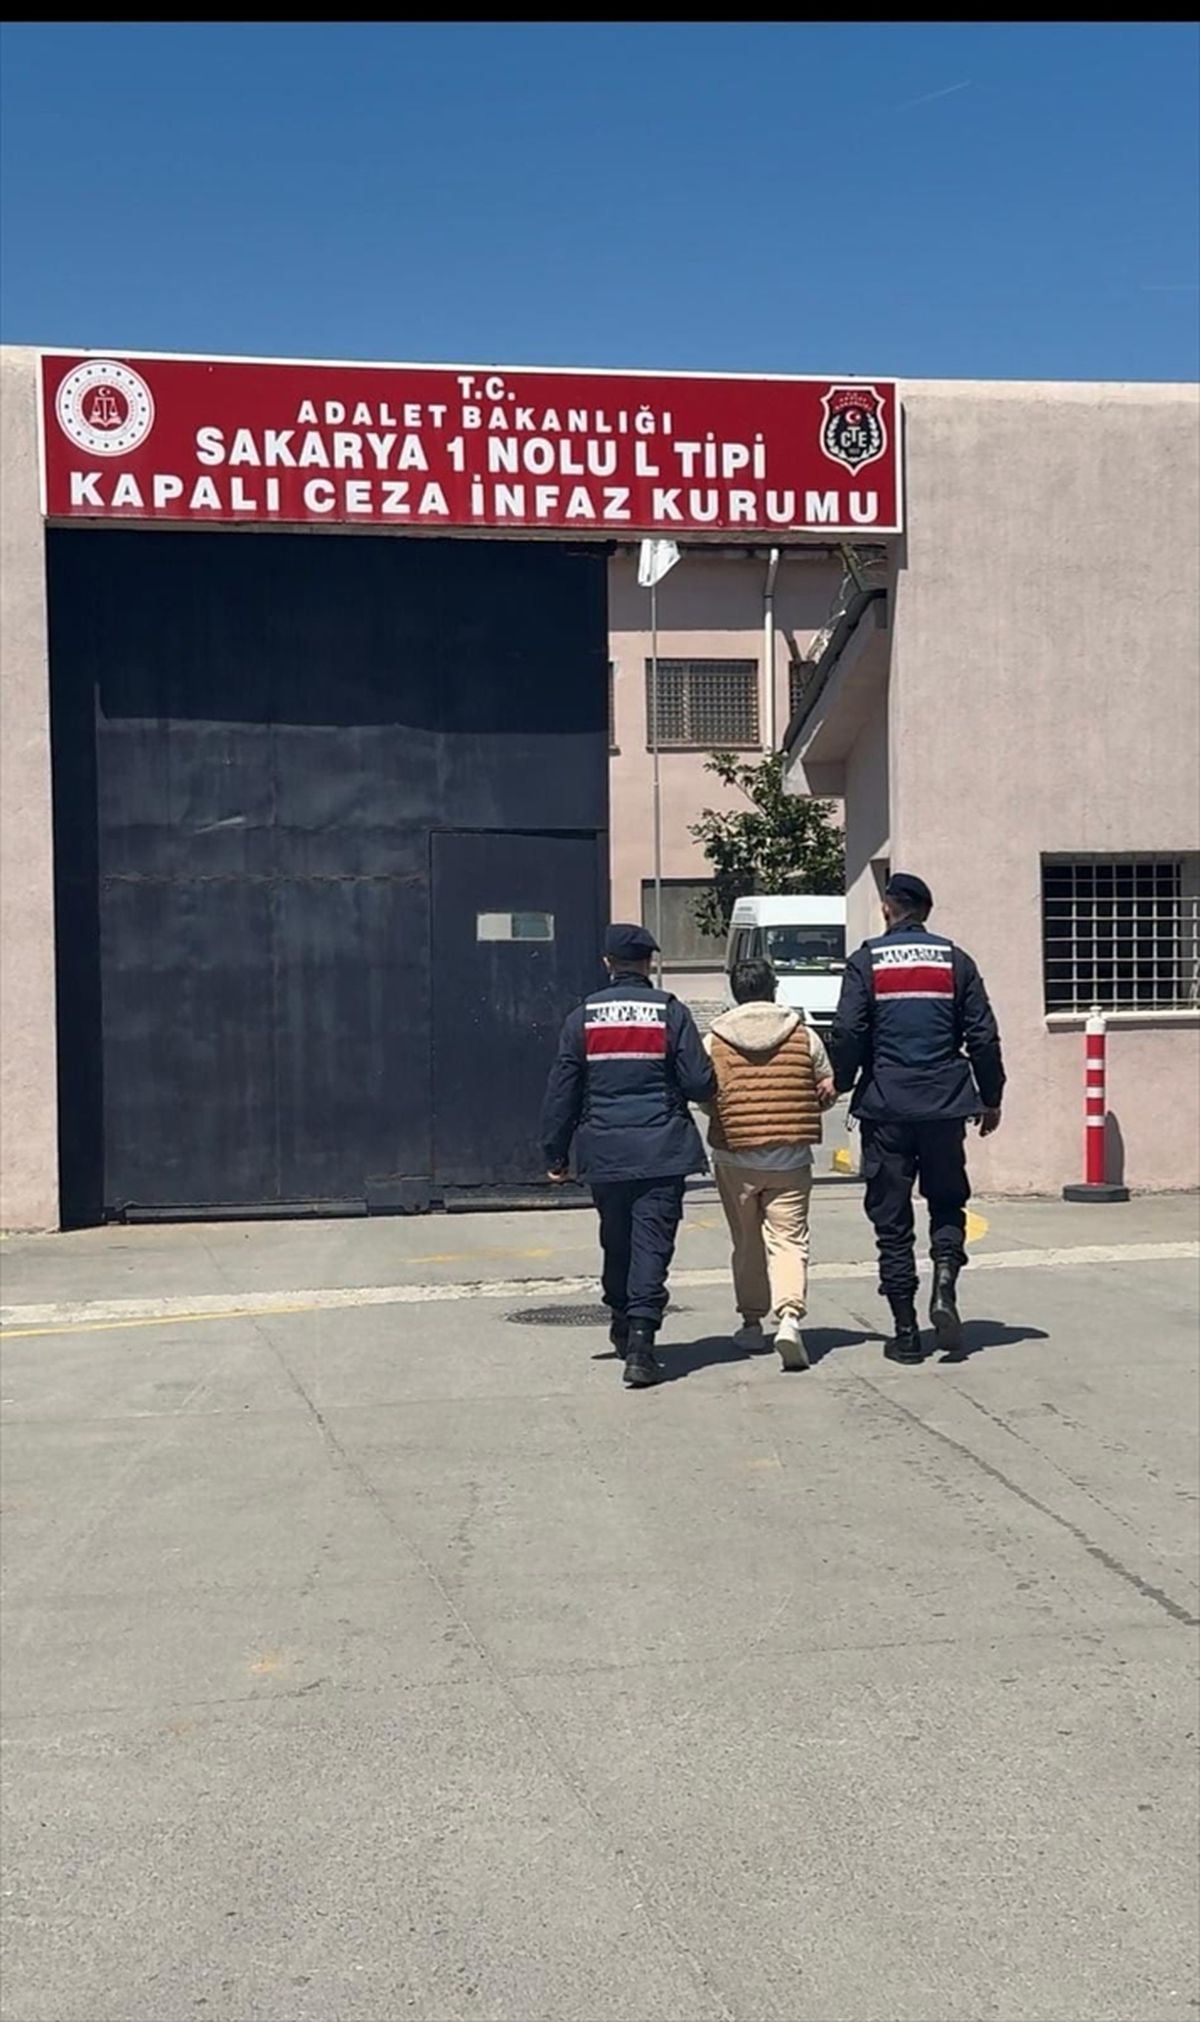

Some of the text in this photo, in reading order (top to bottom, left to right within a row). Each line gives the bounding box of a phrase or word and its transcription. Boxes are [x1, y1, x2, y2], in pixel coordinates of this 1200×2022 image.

[458, 376, 515, 400] T.C.
[298, 401, 671, 434] ADALET BAKANLIĞI
[841, 426, 867, 448] CTE
[196, 427, 765, 479] SAKARYA 1 NOLU L TİPİ
[70, 472, 878, 523] KAPALI CEZA İNFAZ KURUMU
[879, 948, 945, 964] JANDARMA
[592, 1006, 660, 1023] JANDARMA
